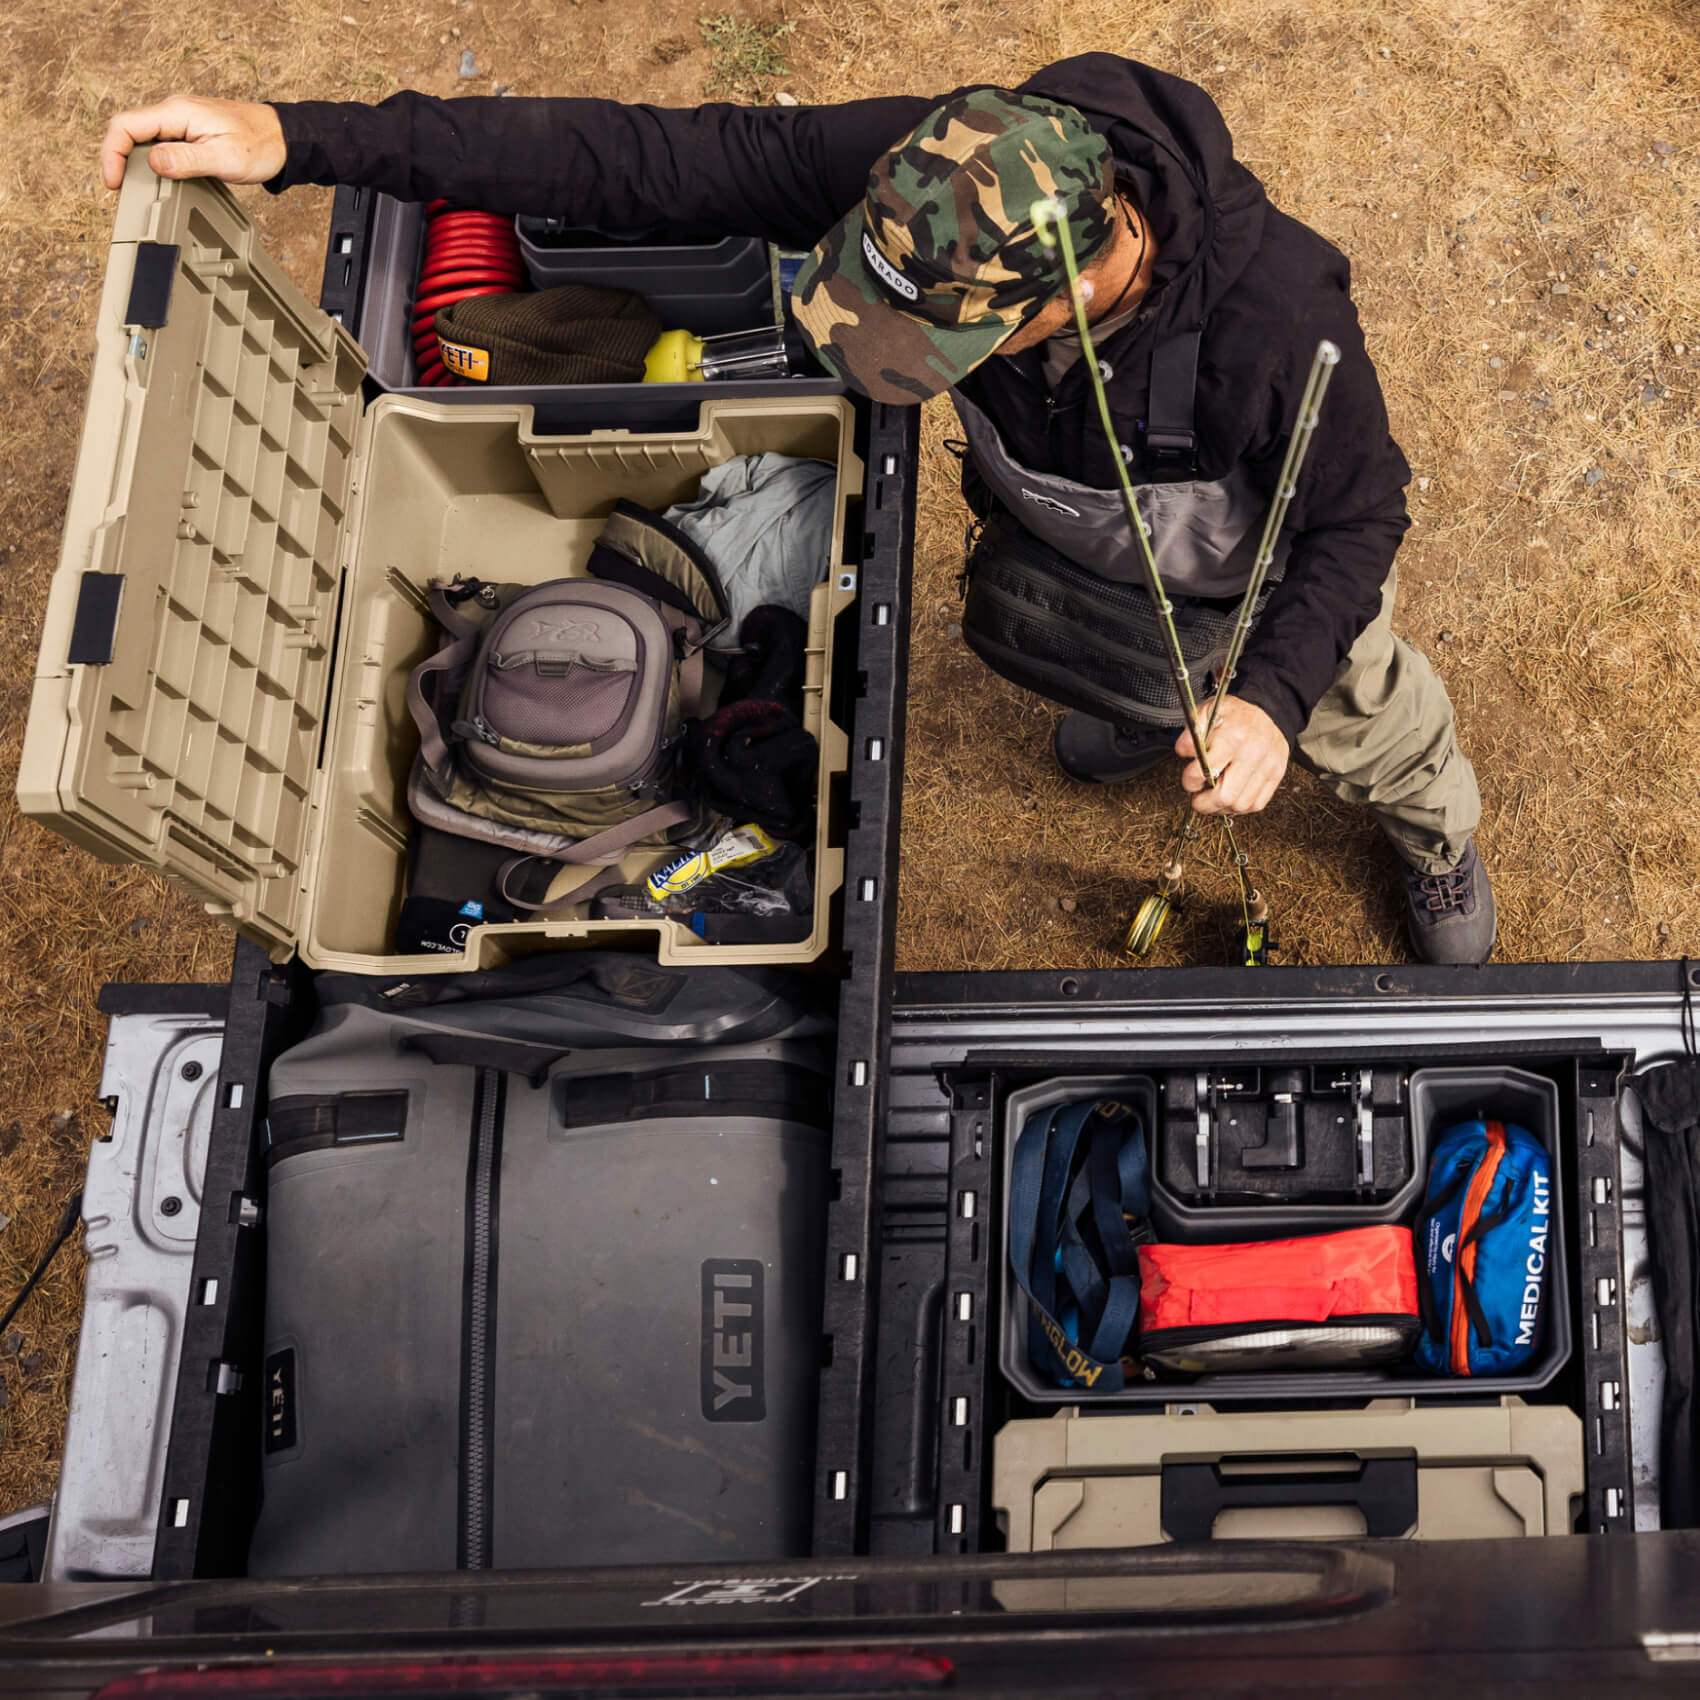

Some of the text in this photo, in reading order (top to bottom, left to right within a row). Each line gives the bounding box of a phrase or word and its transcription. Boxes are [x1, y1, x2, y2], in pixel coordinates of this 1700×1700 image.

[1515, 1170, 1550, 1345] MEDICAL KIT
[713, 1273, 752, 1411] YETI
